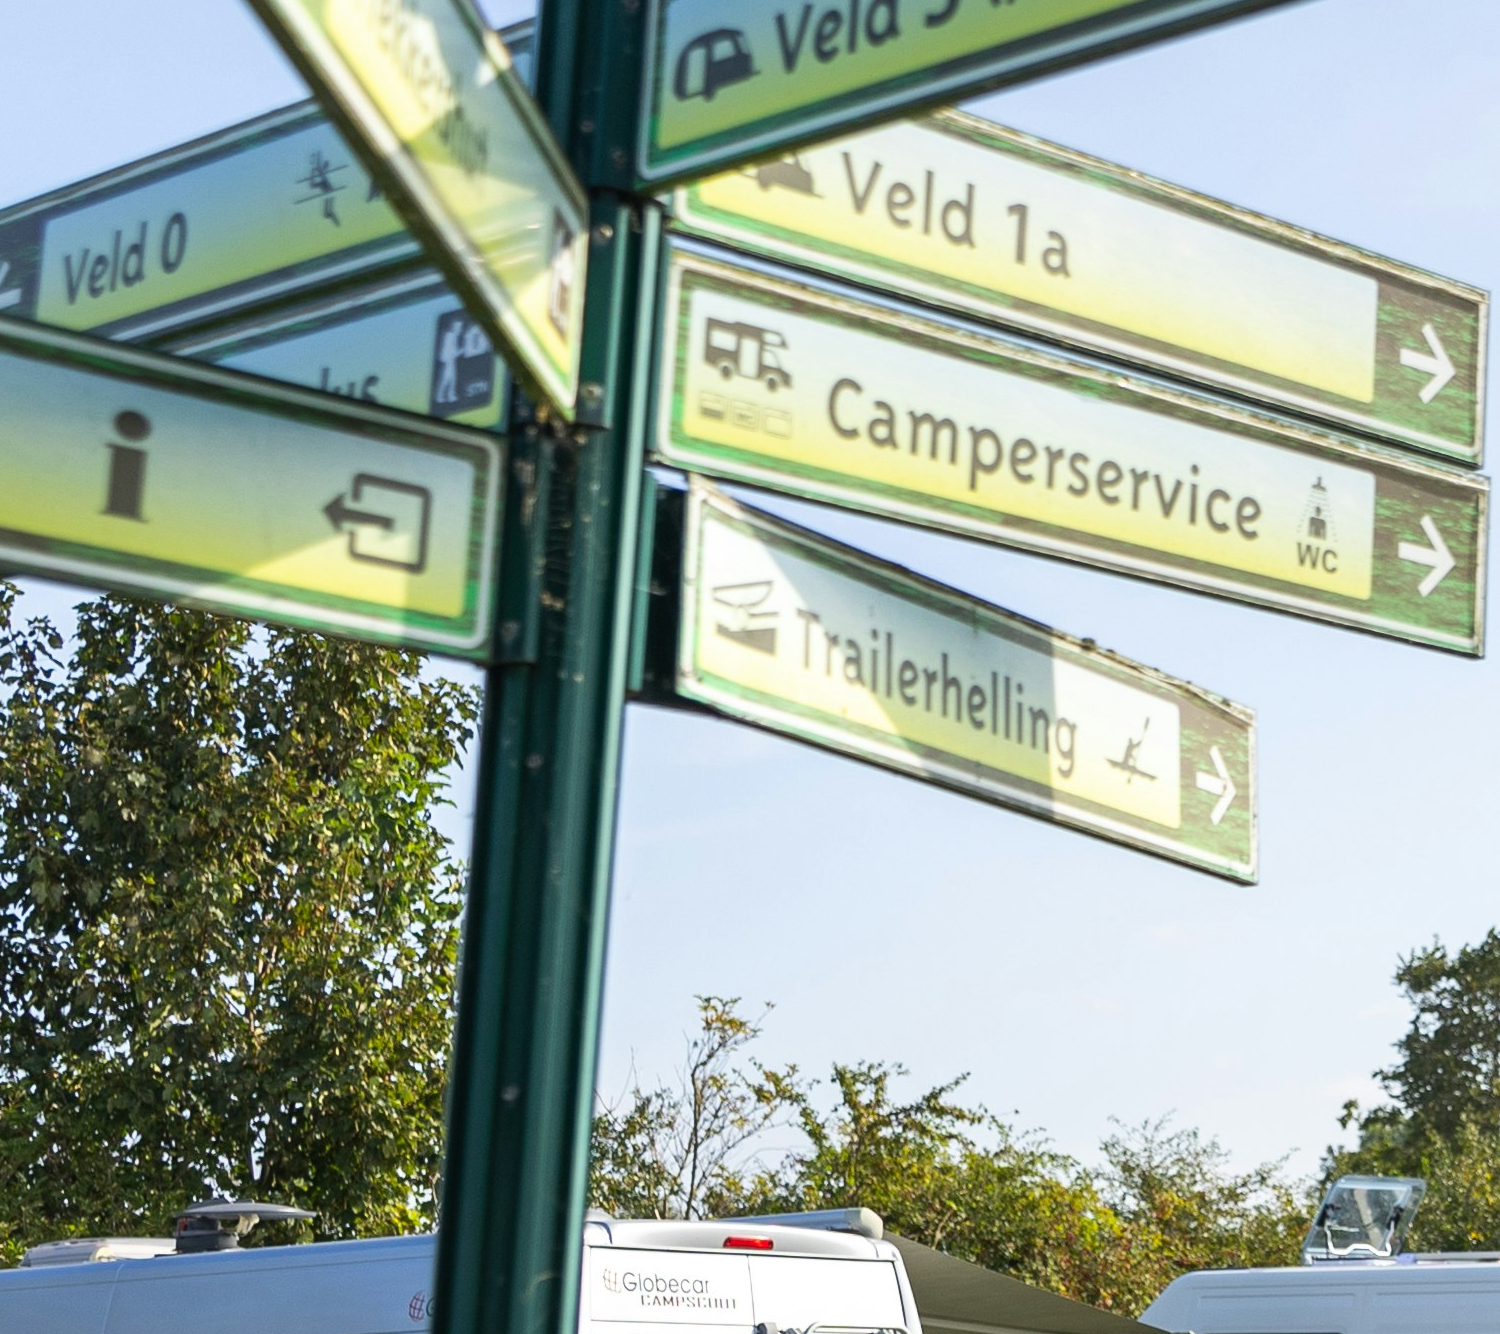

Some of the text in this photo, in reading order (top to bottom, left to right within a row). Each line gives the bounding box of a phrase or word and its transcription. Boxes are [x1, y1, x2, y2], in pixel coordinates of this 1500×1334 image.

[64, 212, 188, 305] Veld 0
[841, 152, 1072, 279] Veld 1a
[826, 378, 1263, 542] Camperservice
[1296, 542, 1339, 574] WC
[796, 608, 1077, 779] Trailerhelling
[622, 1271, 709, 1294] Globecar
